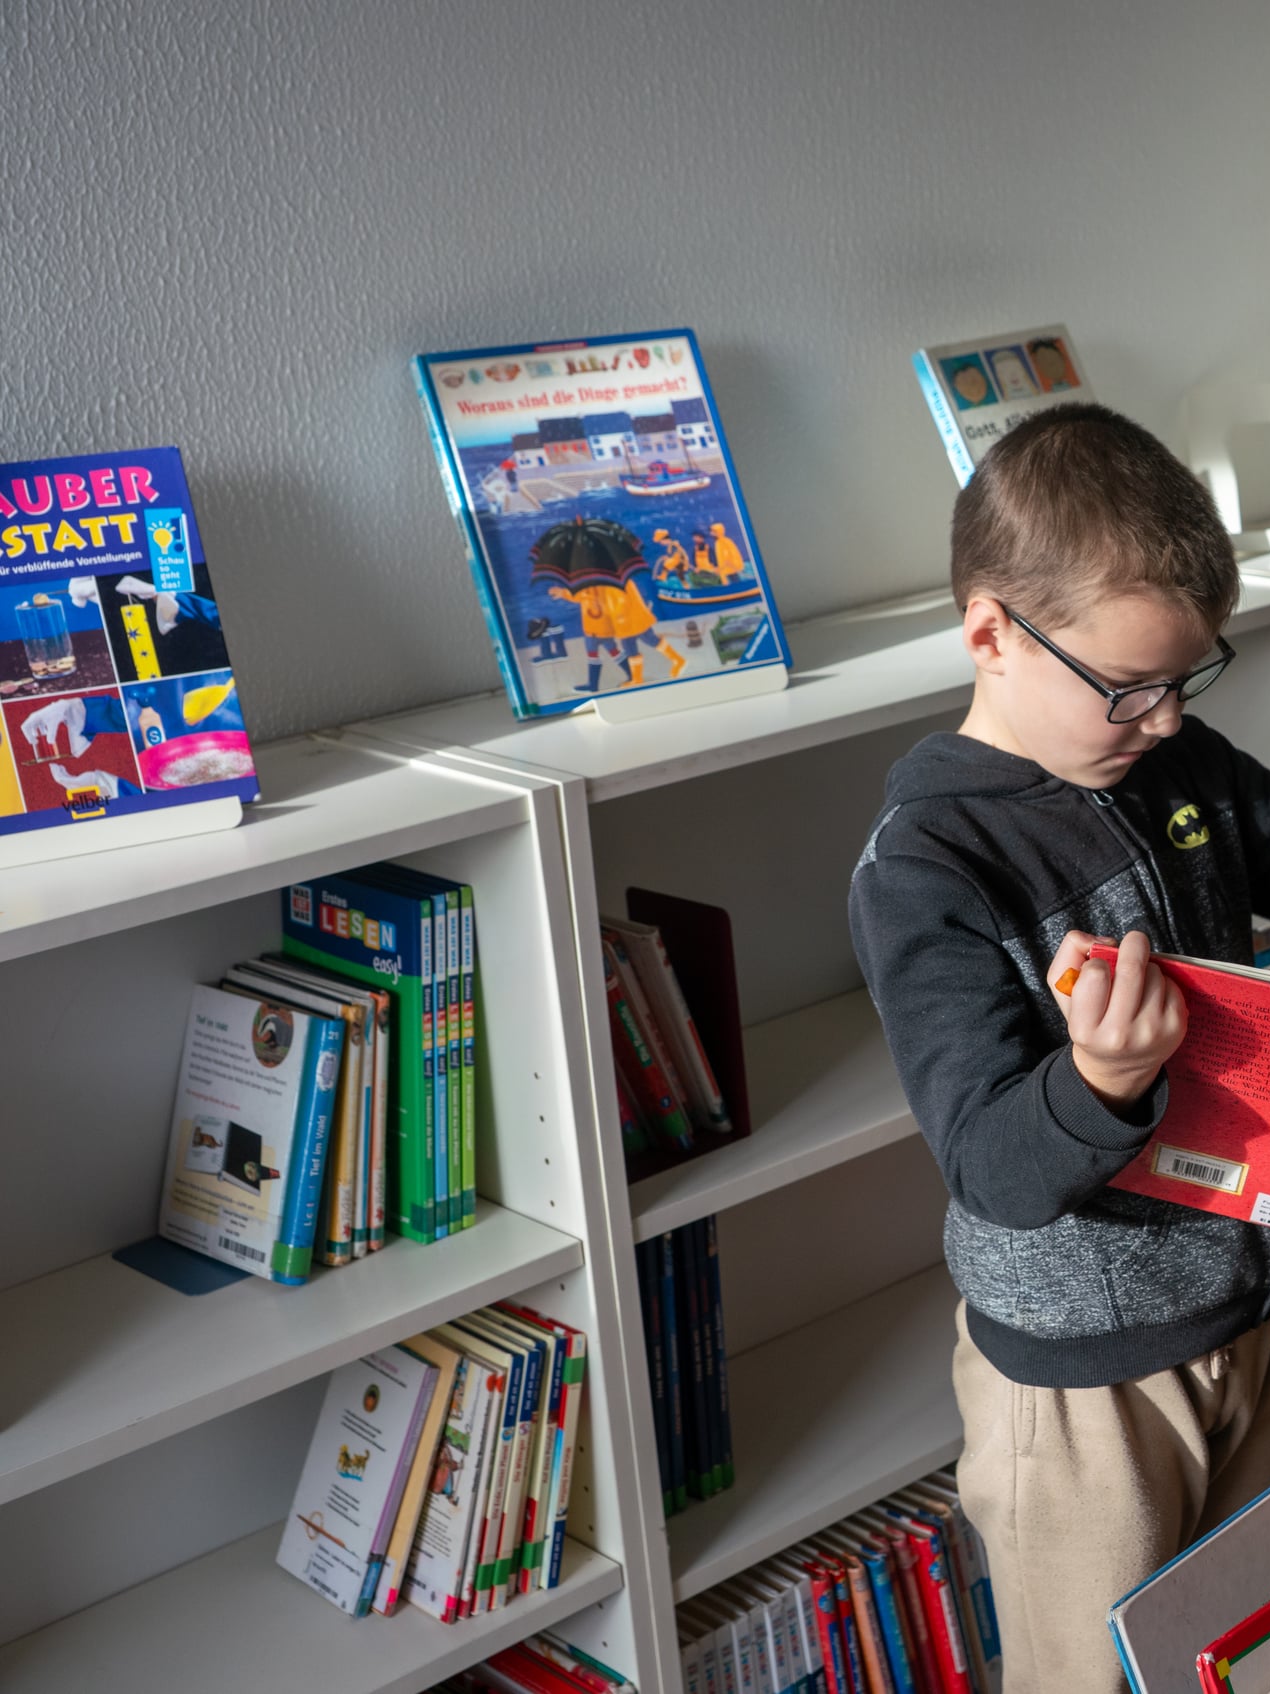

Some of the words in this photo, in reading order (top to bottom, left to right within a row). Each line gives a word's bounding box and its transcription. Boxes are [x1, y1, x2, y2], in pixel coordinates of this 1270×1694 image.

[457, 401, 515, 416] Woraus
[518, 392, 549, 409] sind
[553, 389, 574, 405] die
[578, 385, 618, 403] Dinge
[623, 377, 688, 399] gemacht?
[0, 466, 160, 518] UBER
[0, 513, 138, 558] STATT
[12, 558, 75, 575] verblüffende
[77, 551, 143, 567] Vorstellungen
[62, 795, 111, 812] velber
[322, 906, 394, 949] LESEN
[373, 955, 402, 985] easy!
[1236, 1000, 1251, 1009] ein
